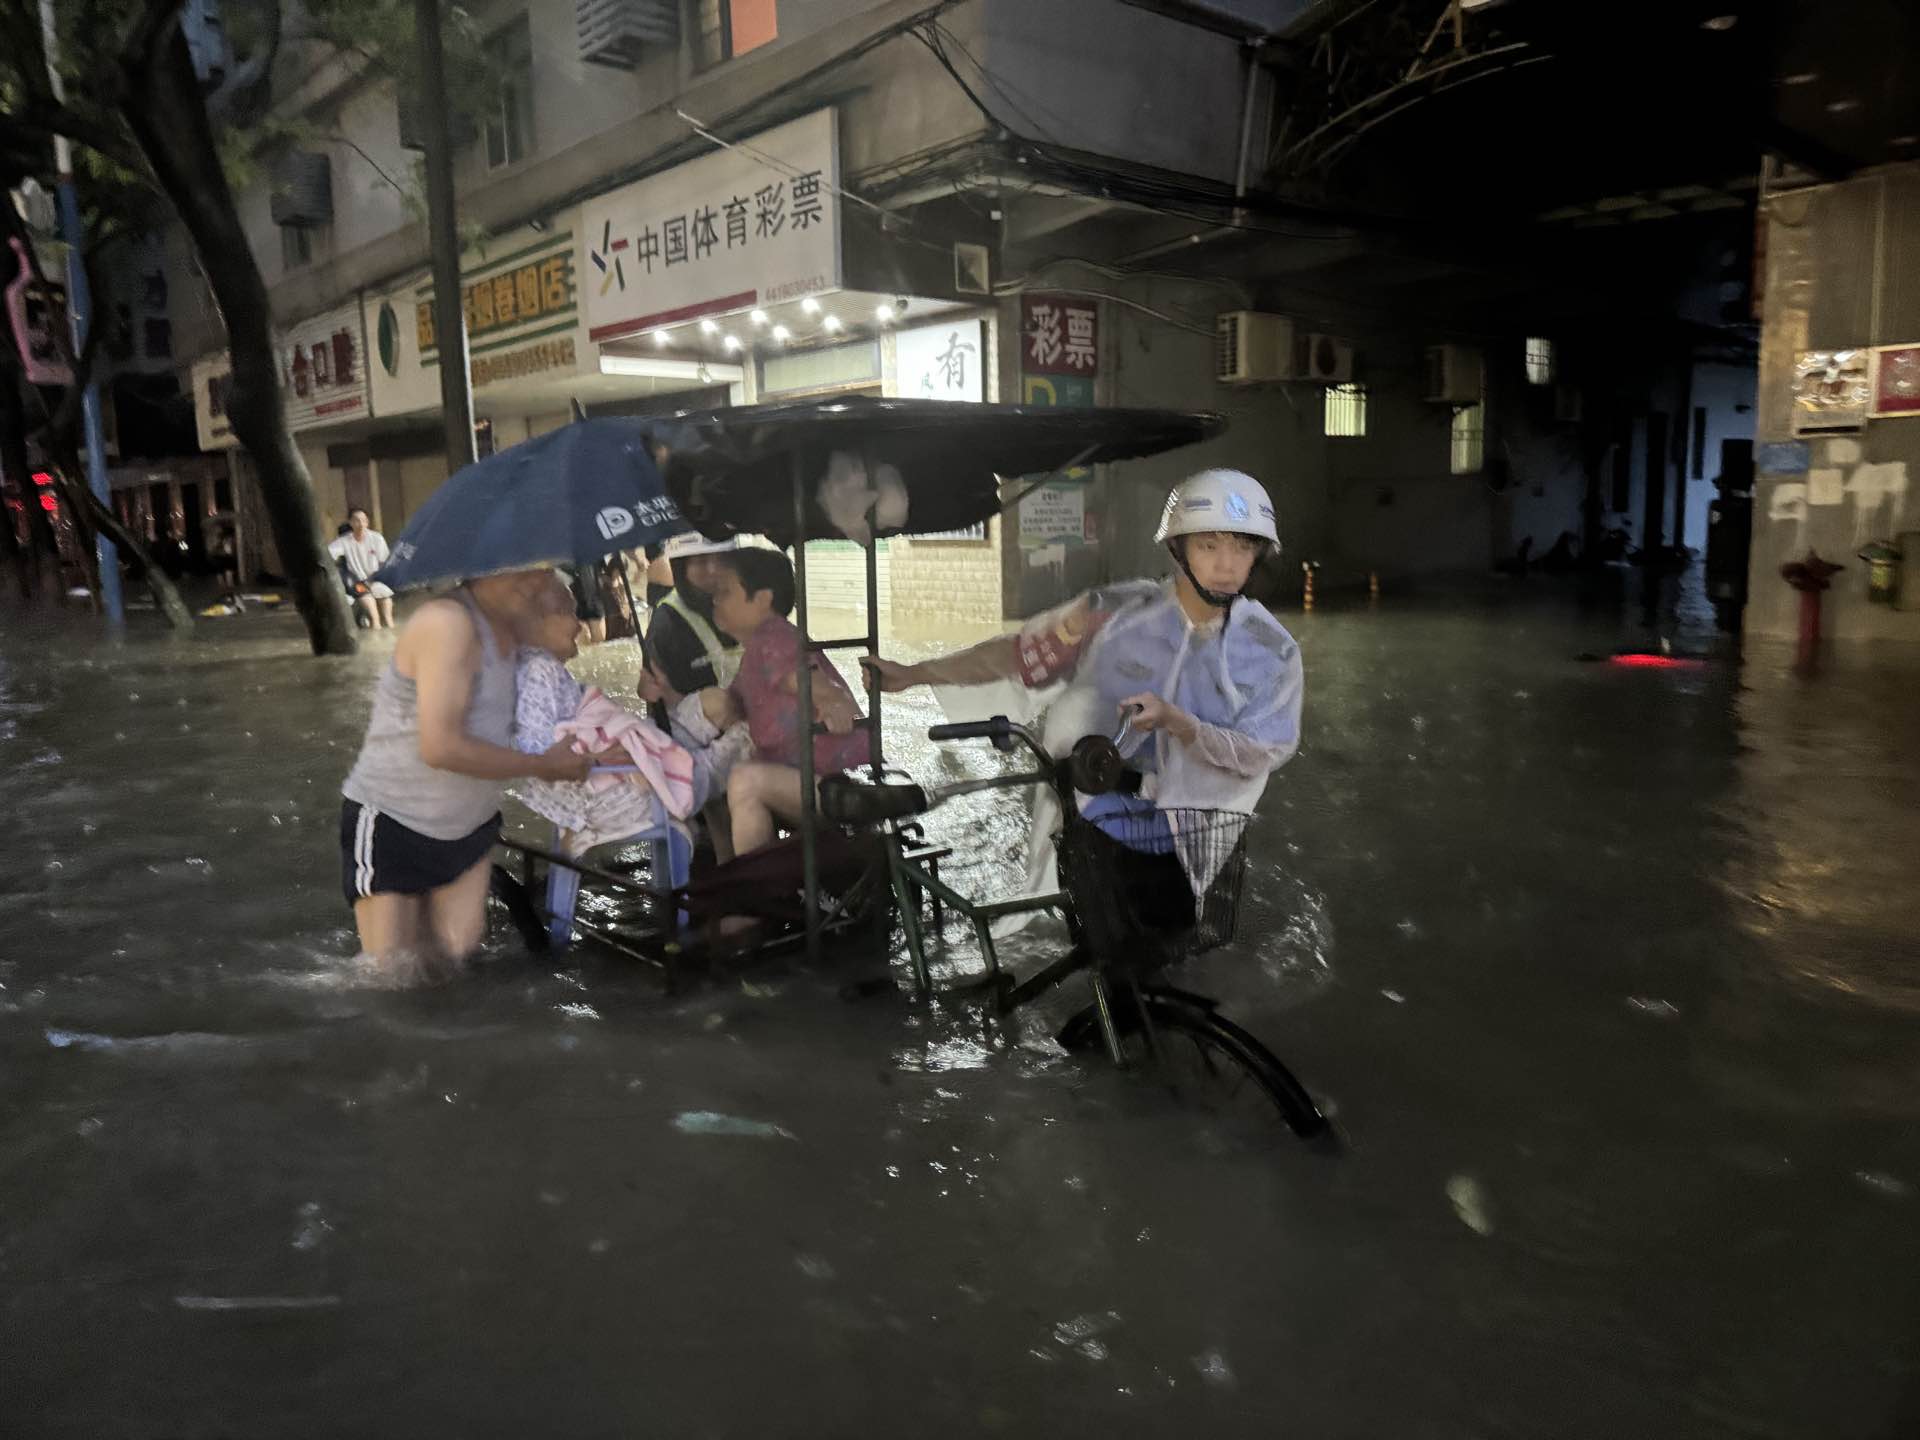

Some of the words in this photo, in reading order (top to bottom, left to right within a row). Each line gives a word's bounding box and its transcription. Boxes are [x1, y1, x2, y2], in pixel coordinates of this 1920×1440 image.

[637, 170, 823, 274] 中国体育彩票
[936, 332, 976, 389] 有
[1030, 304, 1095, 369] 彩票
